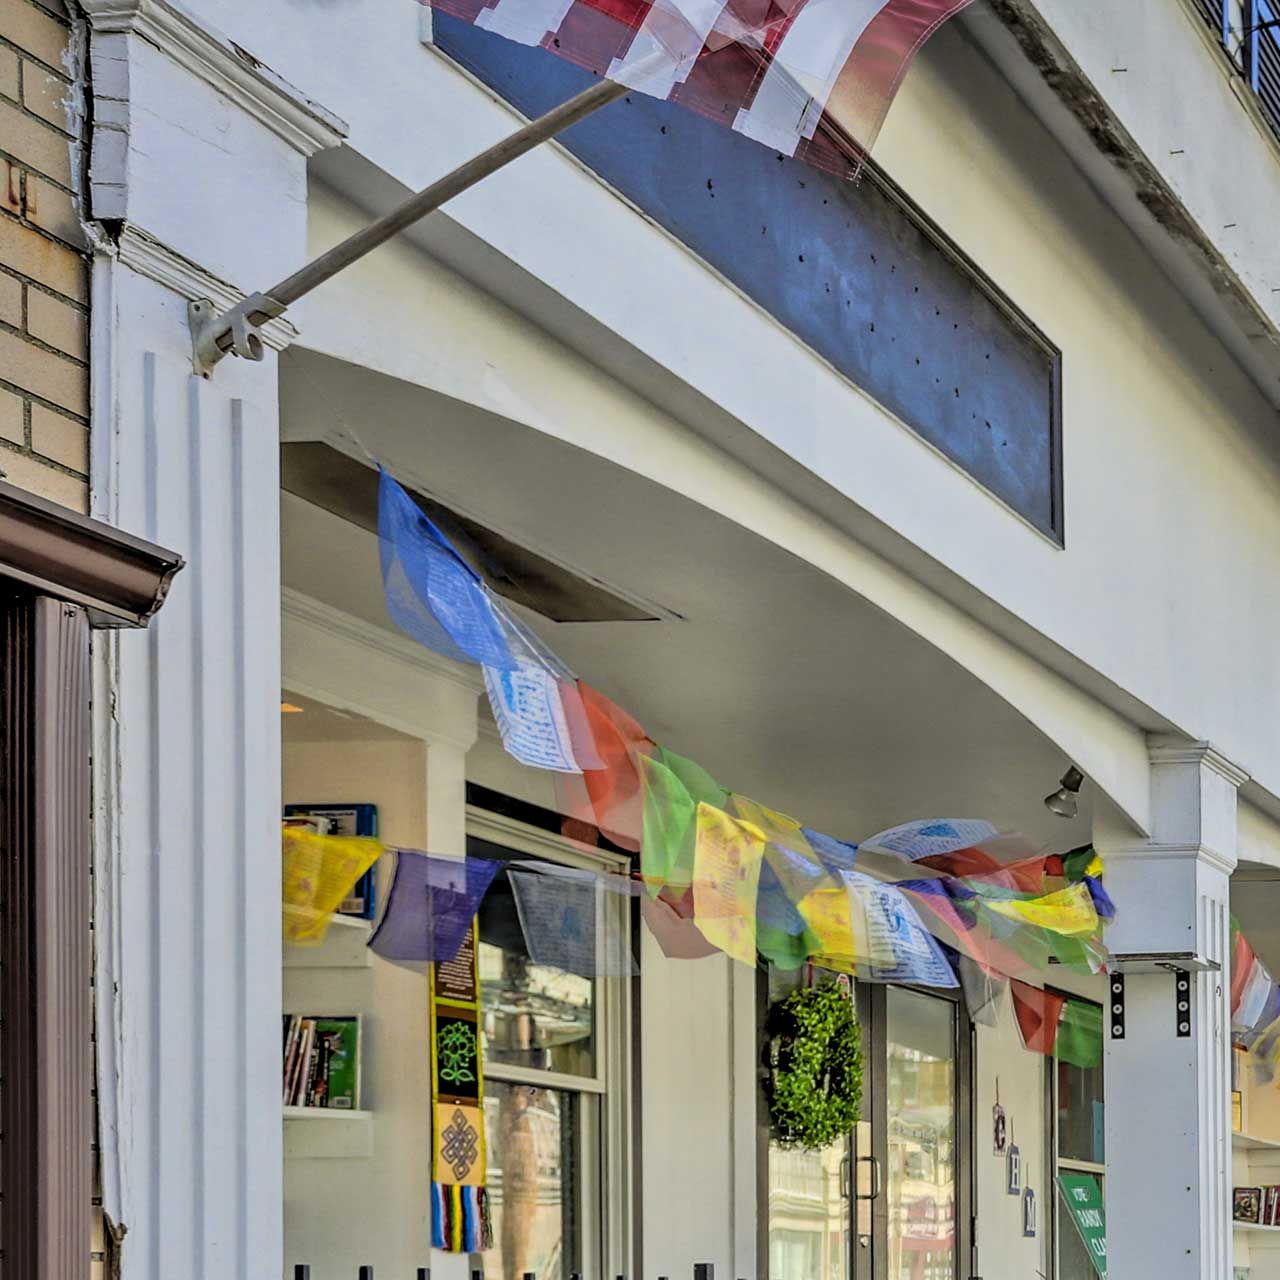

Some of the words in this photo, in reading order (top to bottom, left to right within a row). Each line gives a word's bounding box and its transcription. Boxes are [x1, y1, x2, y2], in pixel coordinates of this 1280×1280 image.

[994, 1113, 1006, 1151] C
[1010, 1153, 1020, 1189] H
[1026, 1195, 1036, 1232] M
